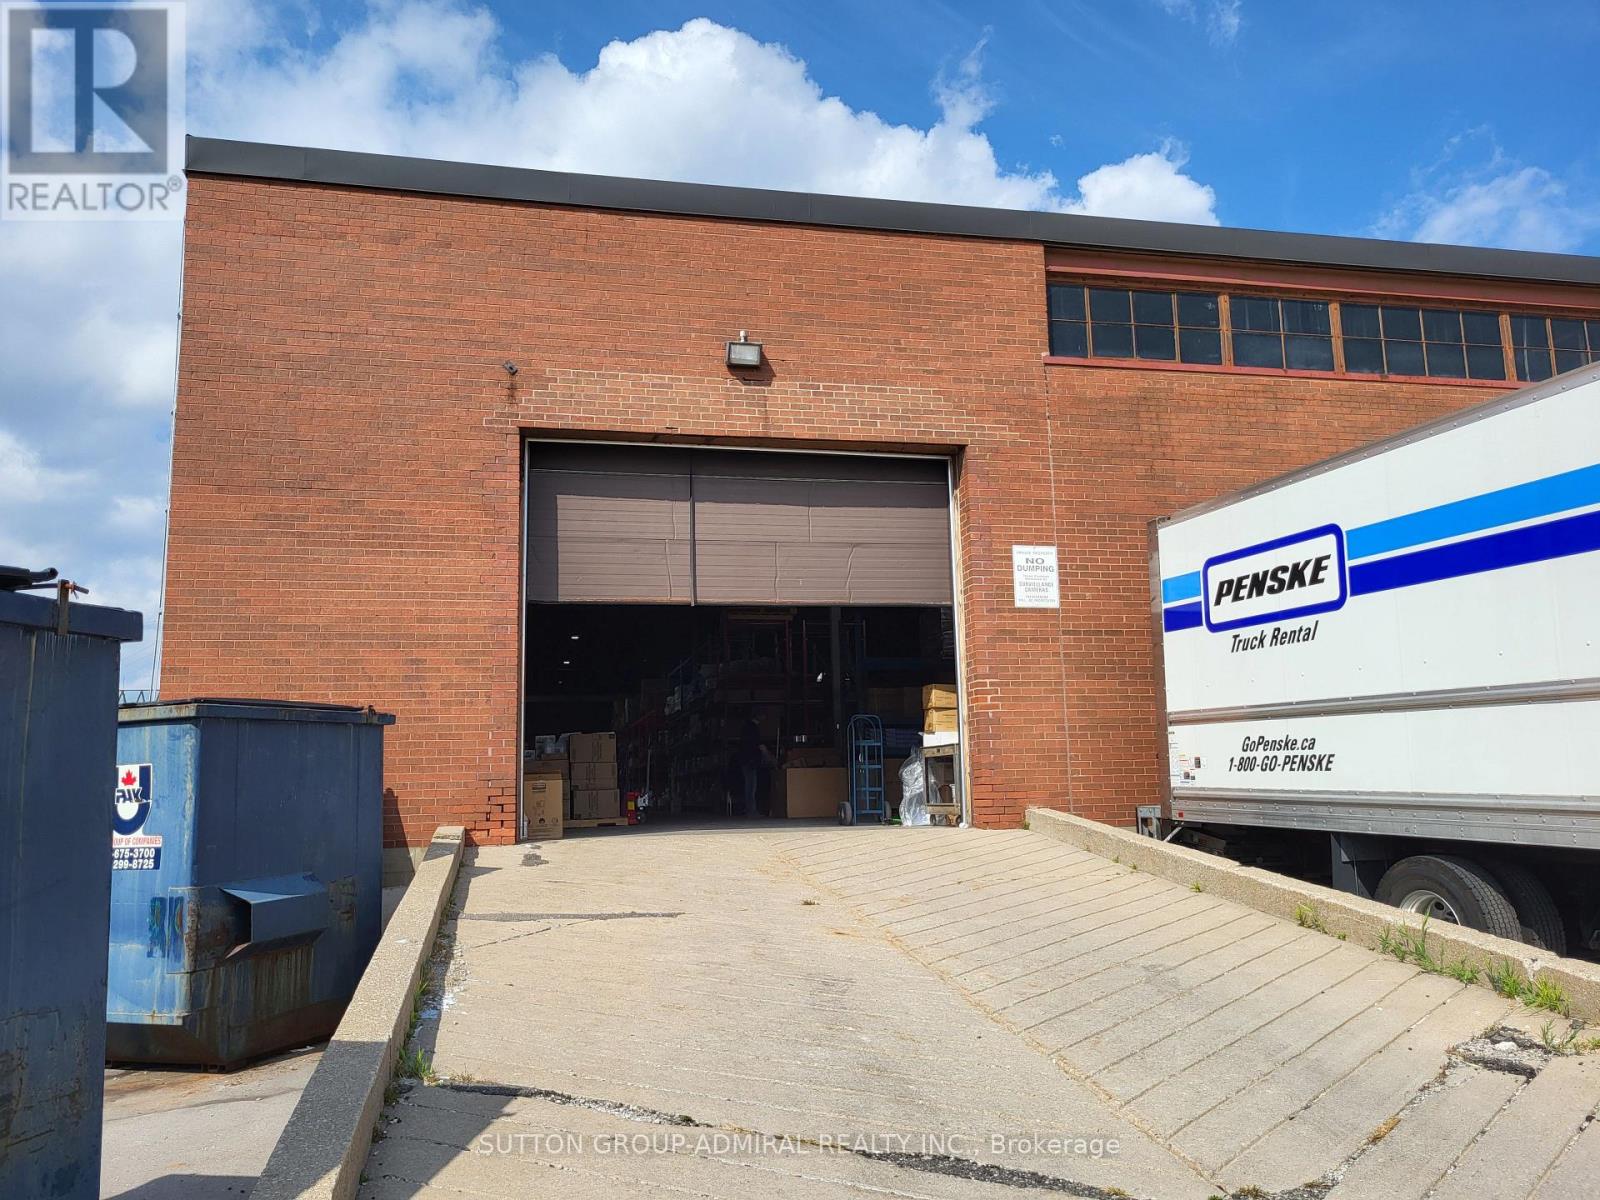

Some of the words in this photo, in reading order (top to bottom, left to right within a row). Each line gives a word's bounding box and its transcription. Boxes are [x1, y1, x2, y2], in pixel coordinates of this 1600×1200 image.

[1214, 554, 1331, 607] PENSKE
[1231, 629, 1266, 653] Truck
[1269, 620, 1319, 648] Rental
[1242, 734, 1316, 753] GoPenske.ca
[1228, 753, 1335, 773] 1-800-GO-PENSKE
